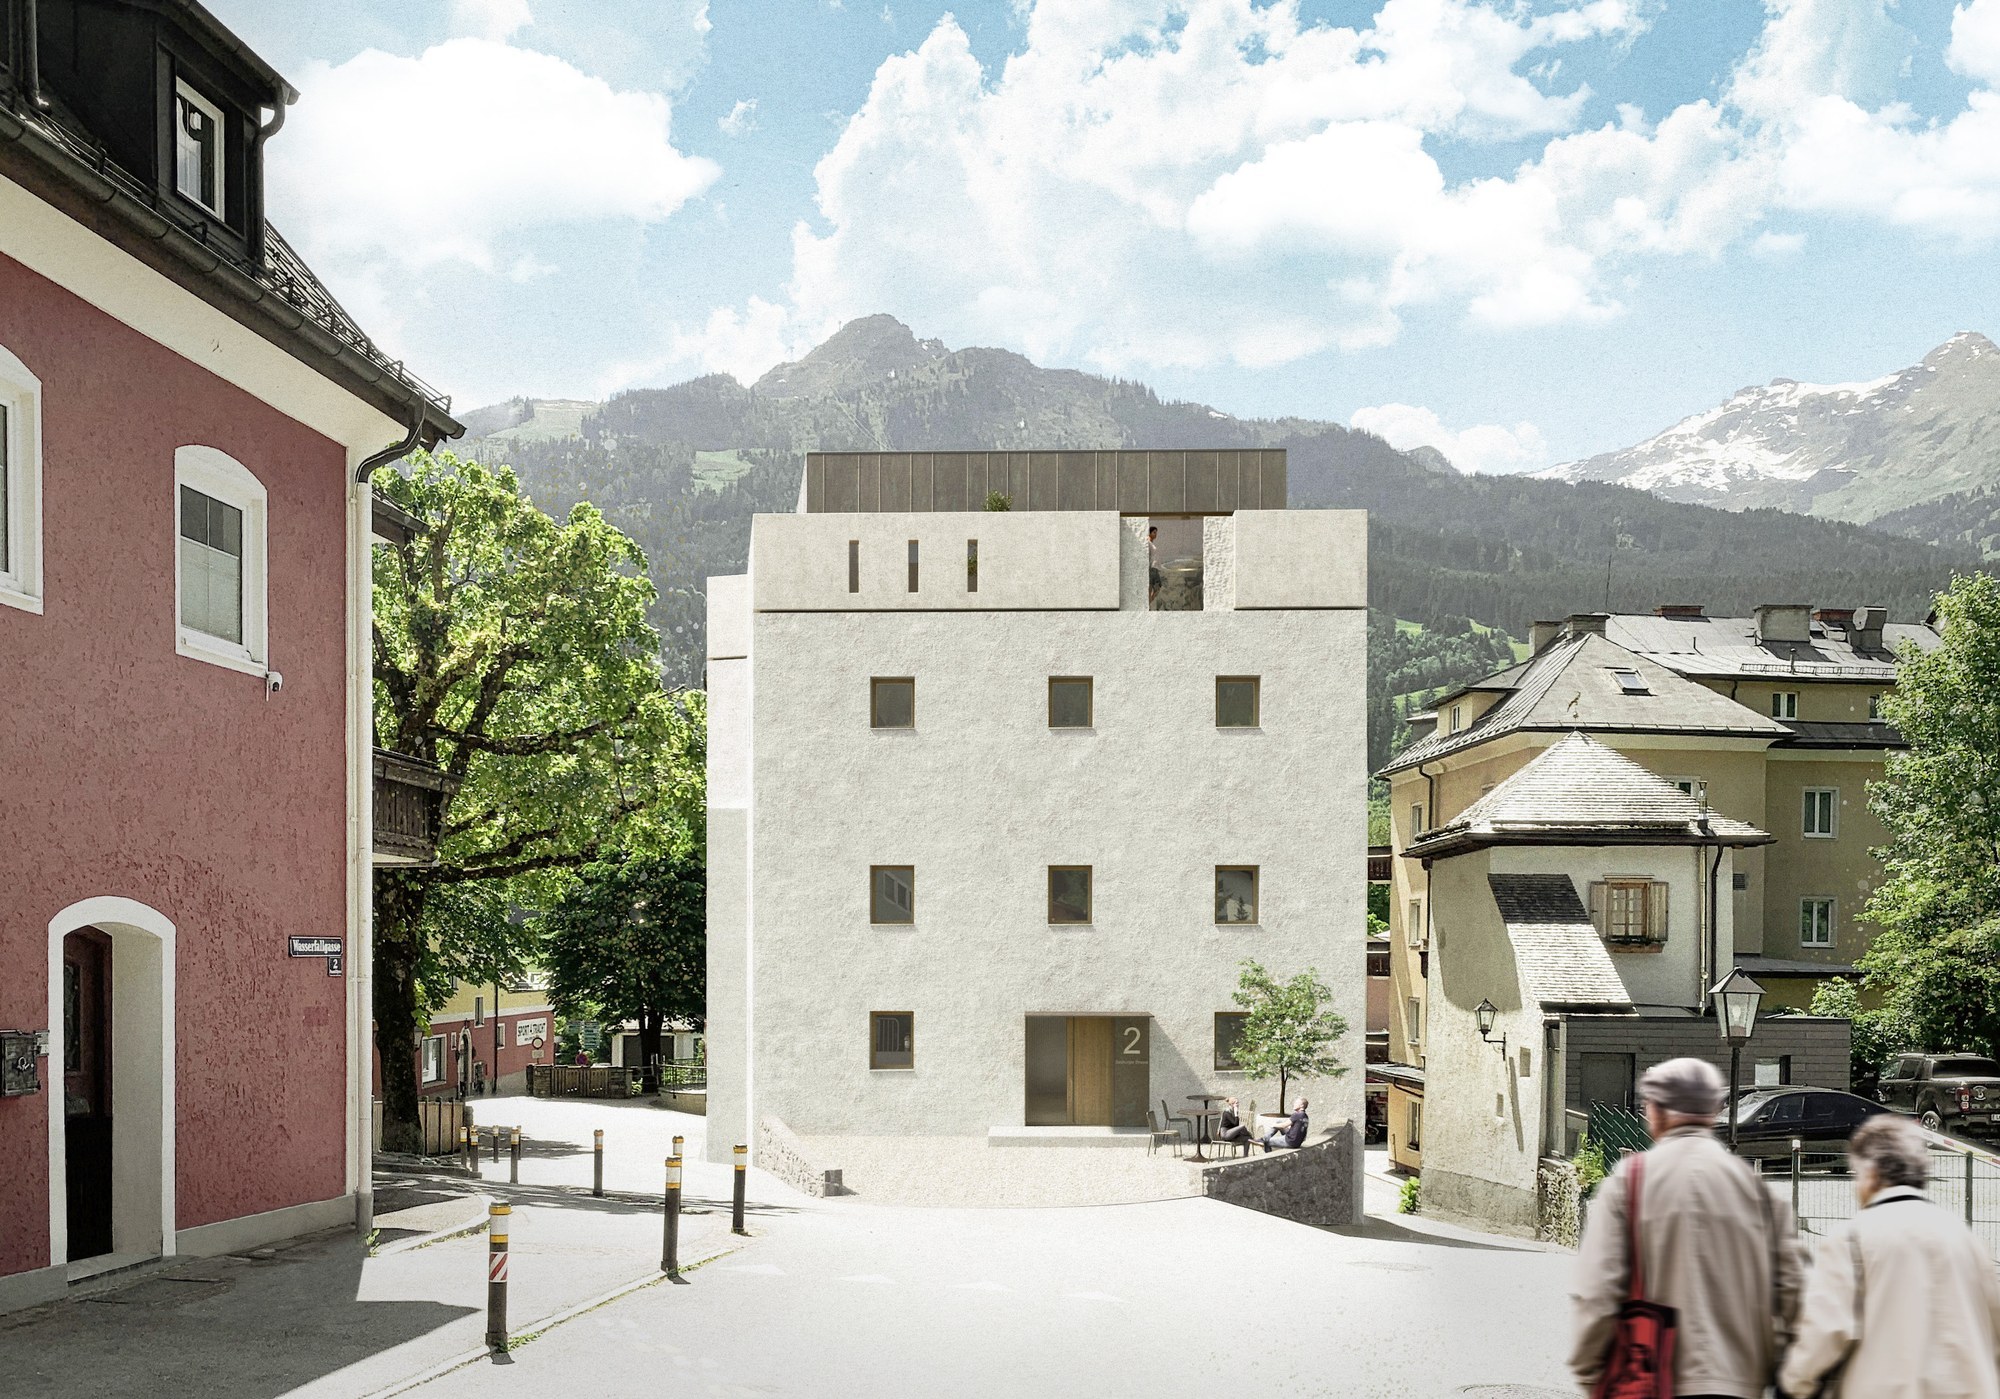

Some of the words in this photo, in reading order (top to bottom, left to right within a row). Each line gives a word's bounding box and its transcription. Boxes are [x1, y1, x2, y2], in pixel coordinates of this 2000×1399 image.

[293, 939, 341, 954] Wasserfallgasse
[333, 959, 338, 969] 2
[1123, 1026, 1141, 1055] 2
